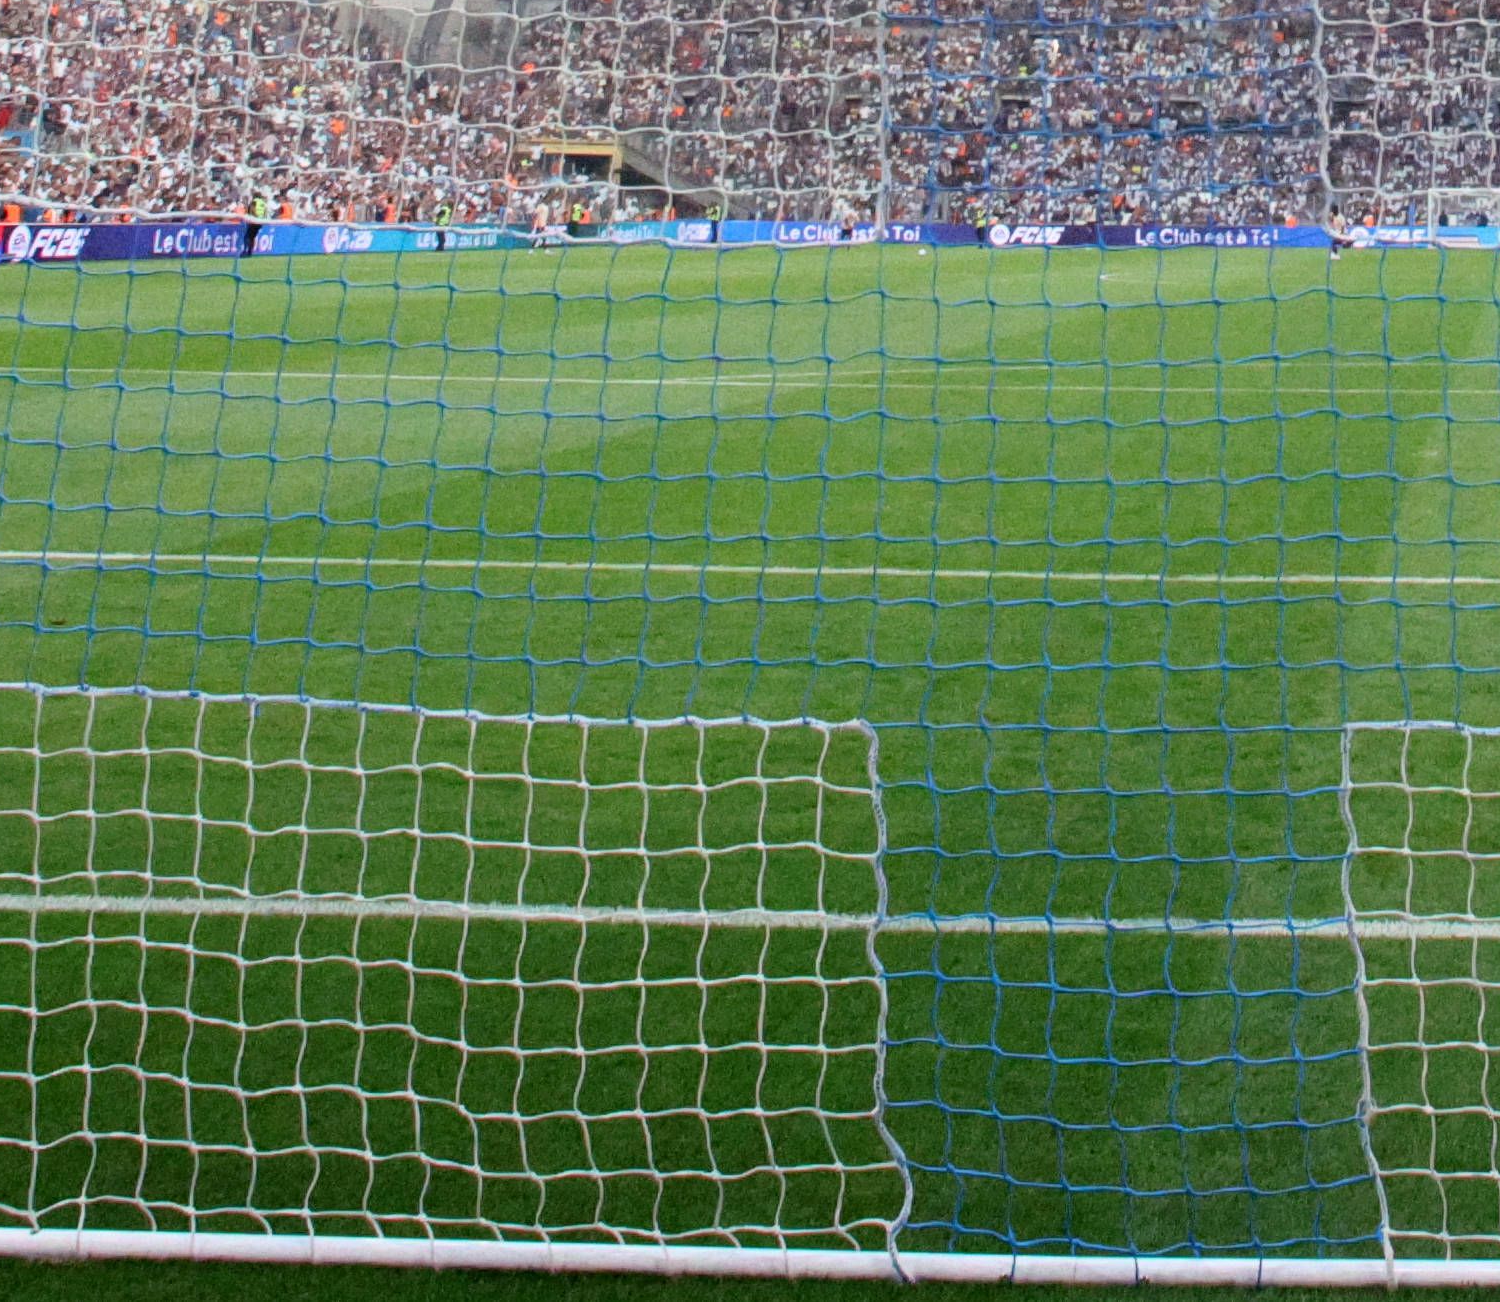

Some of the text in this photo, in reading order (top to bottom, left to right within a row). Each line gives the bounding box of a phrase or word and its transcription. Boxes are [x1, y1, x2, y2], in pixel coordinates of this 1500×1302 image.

[153, 229, 174, 254] Le
[175, 228, 211, 253] Club
[213, 231, 239, 252] est
[779, 225, 800, 241] Le
[892, 226, 920, 241] Toi
[1135, 228, 1157, 245] Le
[1159, 228, 1200, 245] Club
[1204, 229, 1234, 245] est
